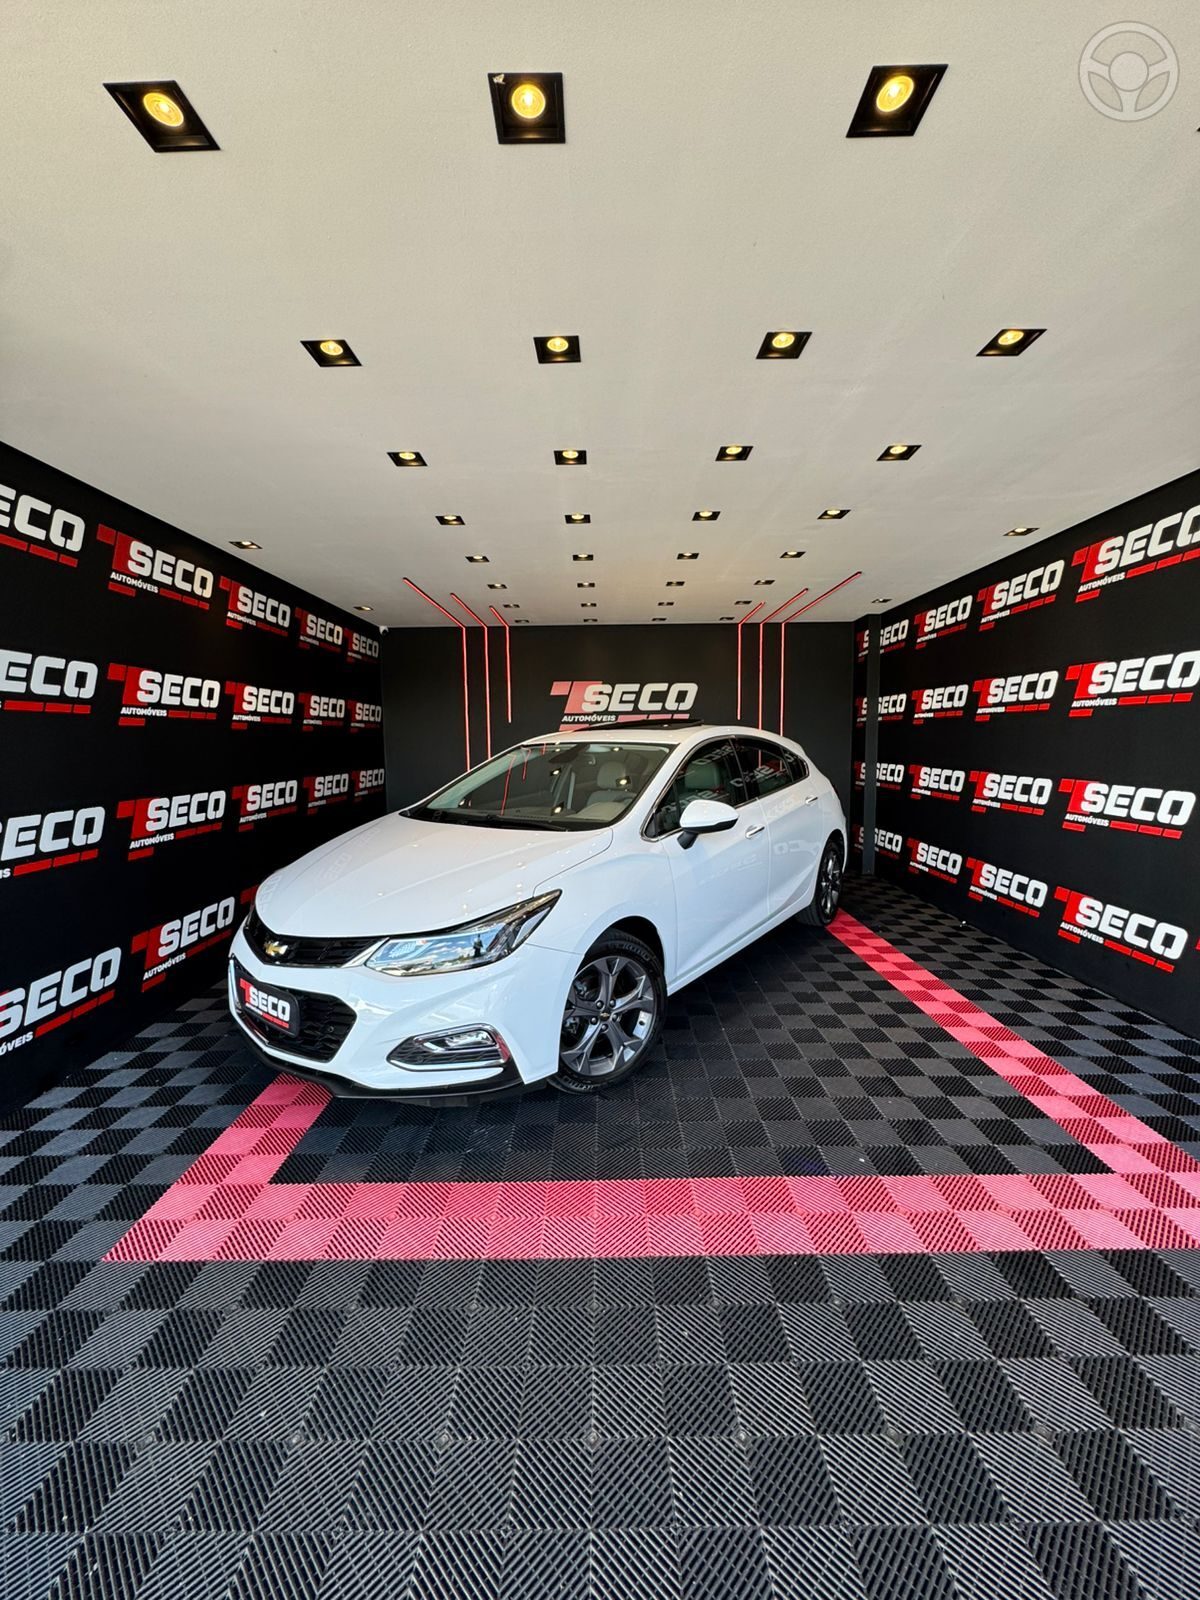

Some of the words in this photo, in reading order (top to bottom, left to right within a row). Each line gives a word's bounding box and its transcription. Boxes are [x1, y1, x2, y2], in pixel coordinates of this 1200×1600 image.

[110, 571, 159, 594] AUTOMÓVEIS
[1078, 572, 1126, 593] AUTOMÓVEIS
[1071, 697, 1118, 708] AUTOMÓVEIS
[120, 706, 167, 718] AUTOMÓVEIS
[561, 713, 617, 722] AUTOMÓVEIS
[1064, 812, 1109, 827] AUTOMÓVEIS
[129, 832, 175, 850] AUTOMÓVEIS
[1060, 920, 1104, 945] AUTOMÓVEIS
[142, 952, 187, 981] AUTOMÓVEIS
